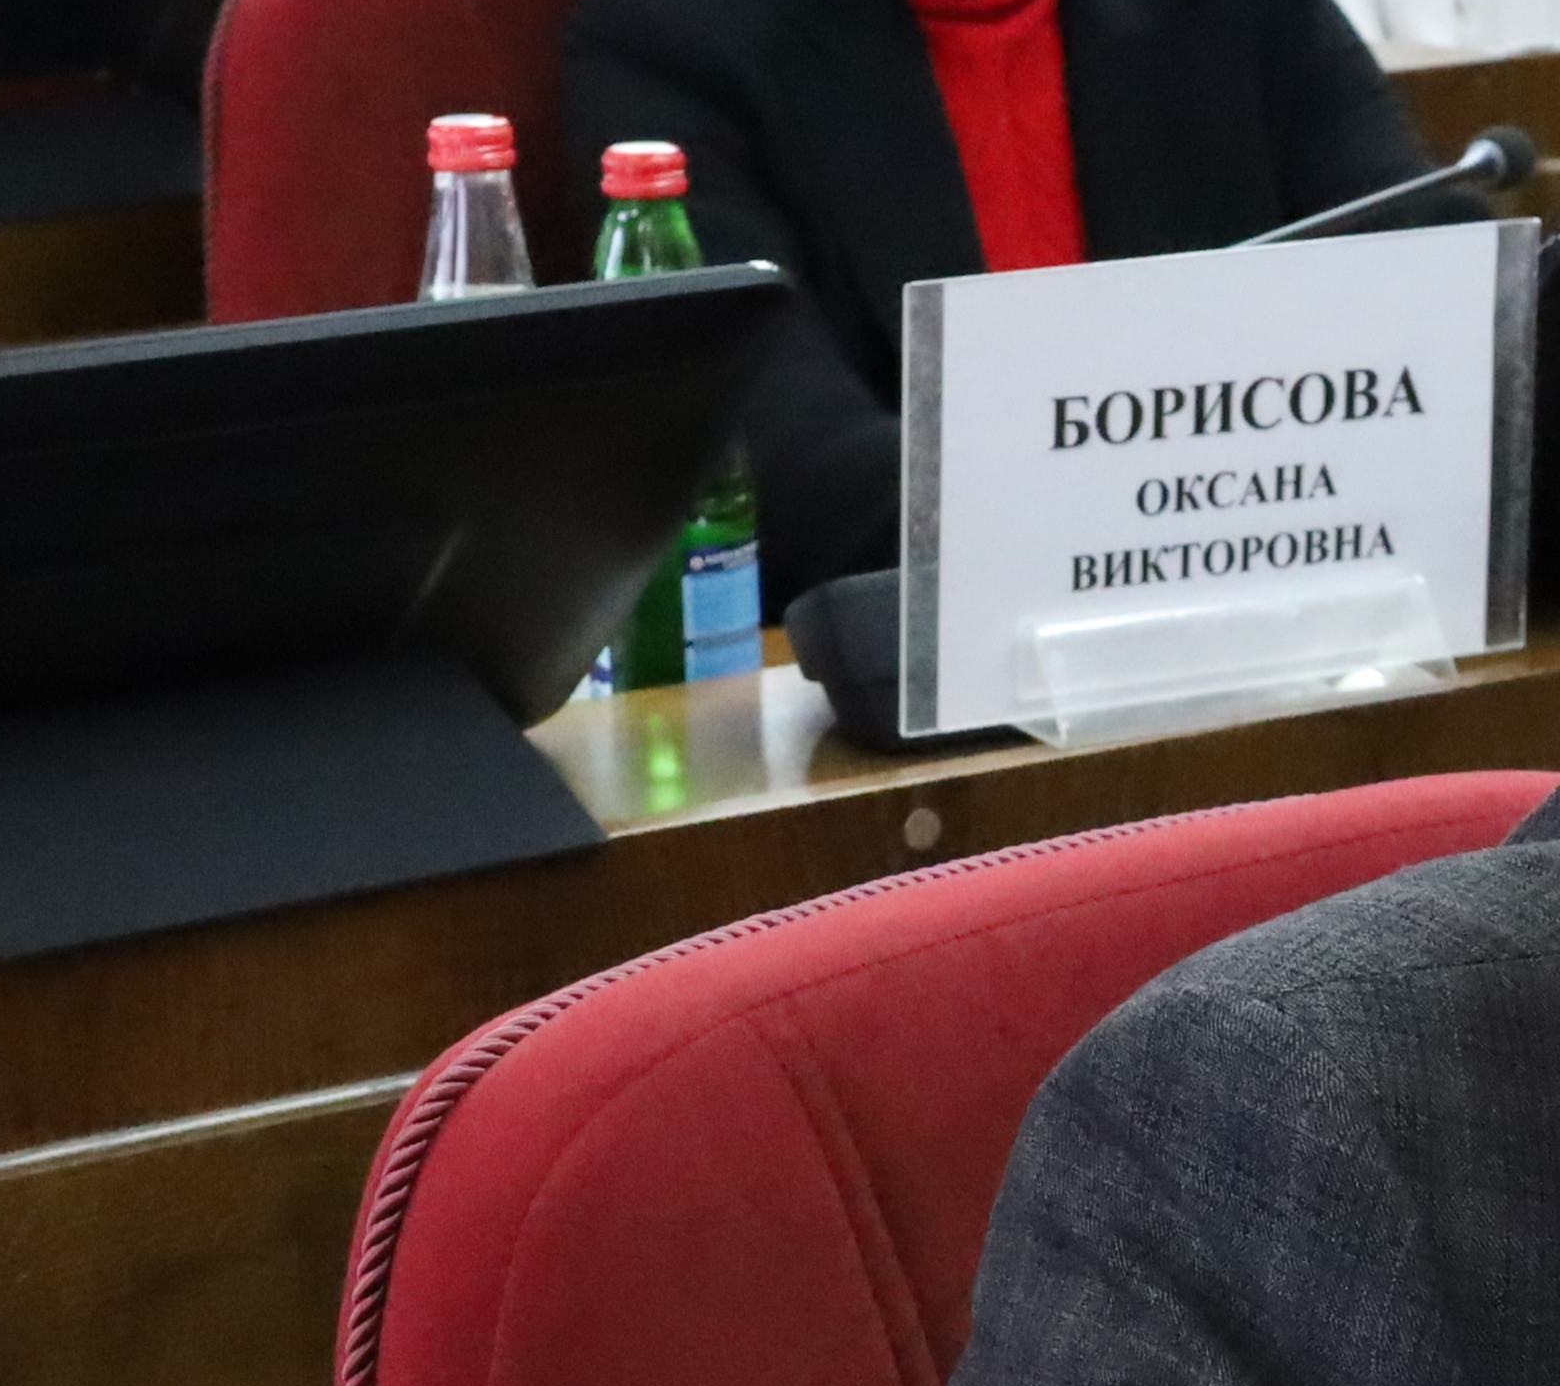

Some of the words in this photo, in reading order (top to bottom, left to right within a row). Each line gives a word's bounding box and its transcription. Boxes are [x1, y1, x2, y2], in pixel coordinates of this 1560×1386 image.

[1050, 365, 1424, 450] БОРИСОВА
[1135, 462, 1336, 516] ОКСАНА
[1071, 522, 1395, 591] ВИКТОРОВНА
